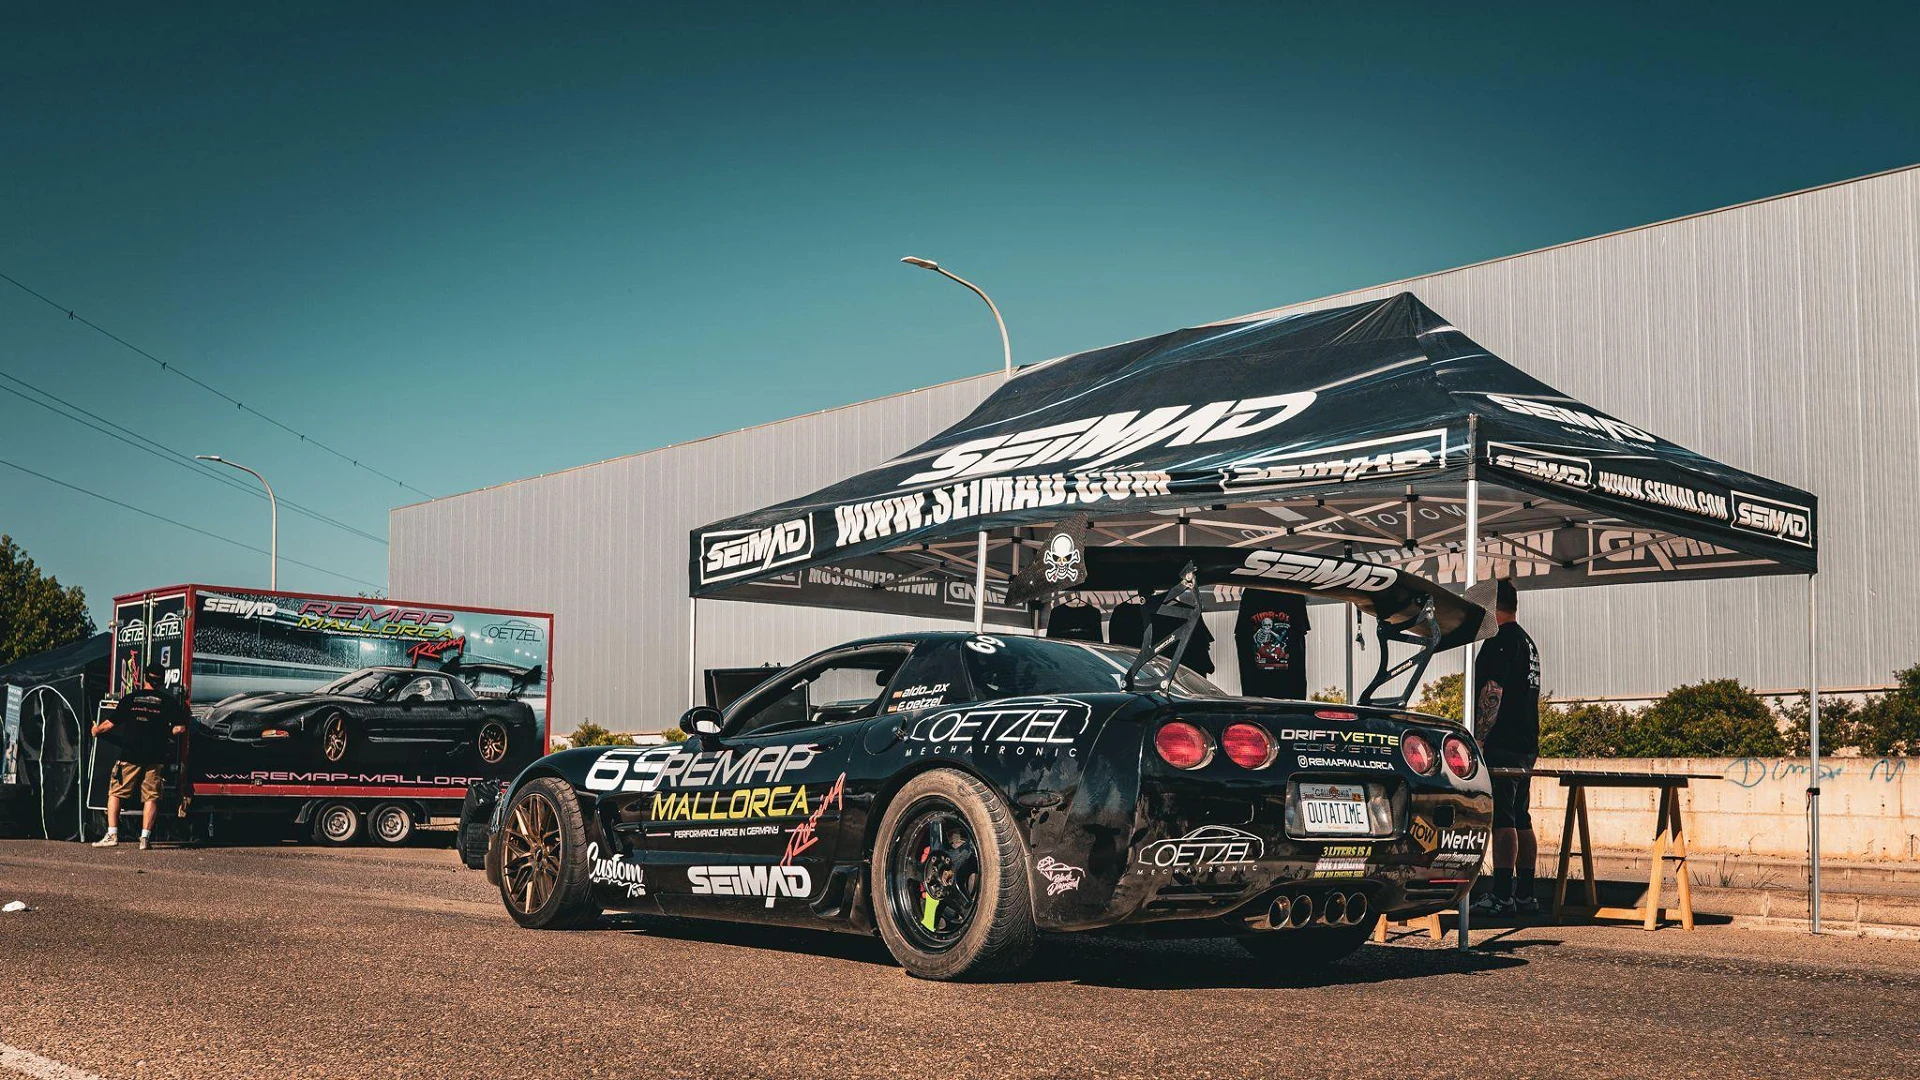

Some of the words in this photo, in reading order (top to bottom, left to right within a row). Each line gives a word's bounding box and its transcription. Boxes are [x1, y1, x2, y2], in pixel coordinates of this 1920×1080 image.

[1599, 471, 1728, 520] WWW.SEIMAD.COM
[298, 601, 455, 626] REMAP
[155, 621, 181, 636] OETZEL
[297, 617, 454, 639] MALLORCA
[488, 626, 541, 643] OETZEL
[407, 636, 466, 668] Racing
[966, 635, 1006, 654] 69
[902, 683, 950, 698] aldo_px
[897, 696, 944, 711] E.oetzel
[929, 709, 1075, 743] OETZEL
[1281, 729, 1399, 746] DRIFTVETTE
[905, 745, 1077, 758] MECHATRONIC
[585, 745, 683, 792] 69
[652, 744, 819, 787] REMAP
[651, 785, 809, 821] MALLORCA
[1307, 802, 1364, 824] OUTATIME
[674, 829, 719, 839] PERFORMANCE
[720, 828, 737, 837] MADE
[739, 828, 746, 836] IN
[746, 825, 780, 836] GERMANY
[1410, 822, 1437, 844] TOW
[1441, 830, 1487, 850] Werk4
[1155, 843, 1255, 867] OETZEL
[1321, 846, 1329, 857] 3
[1365, 846, 1373, 857] A
[587, 842, 644, 884] Custom
[1136, 864, 1258, 876] MECHATRONIC
